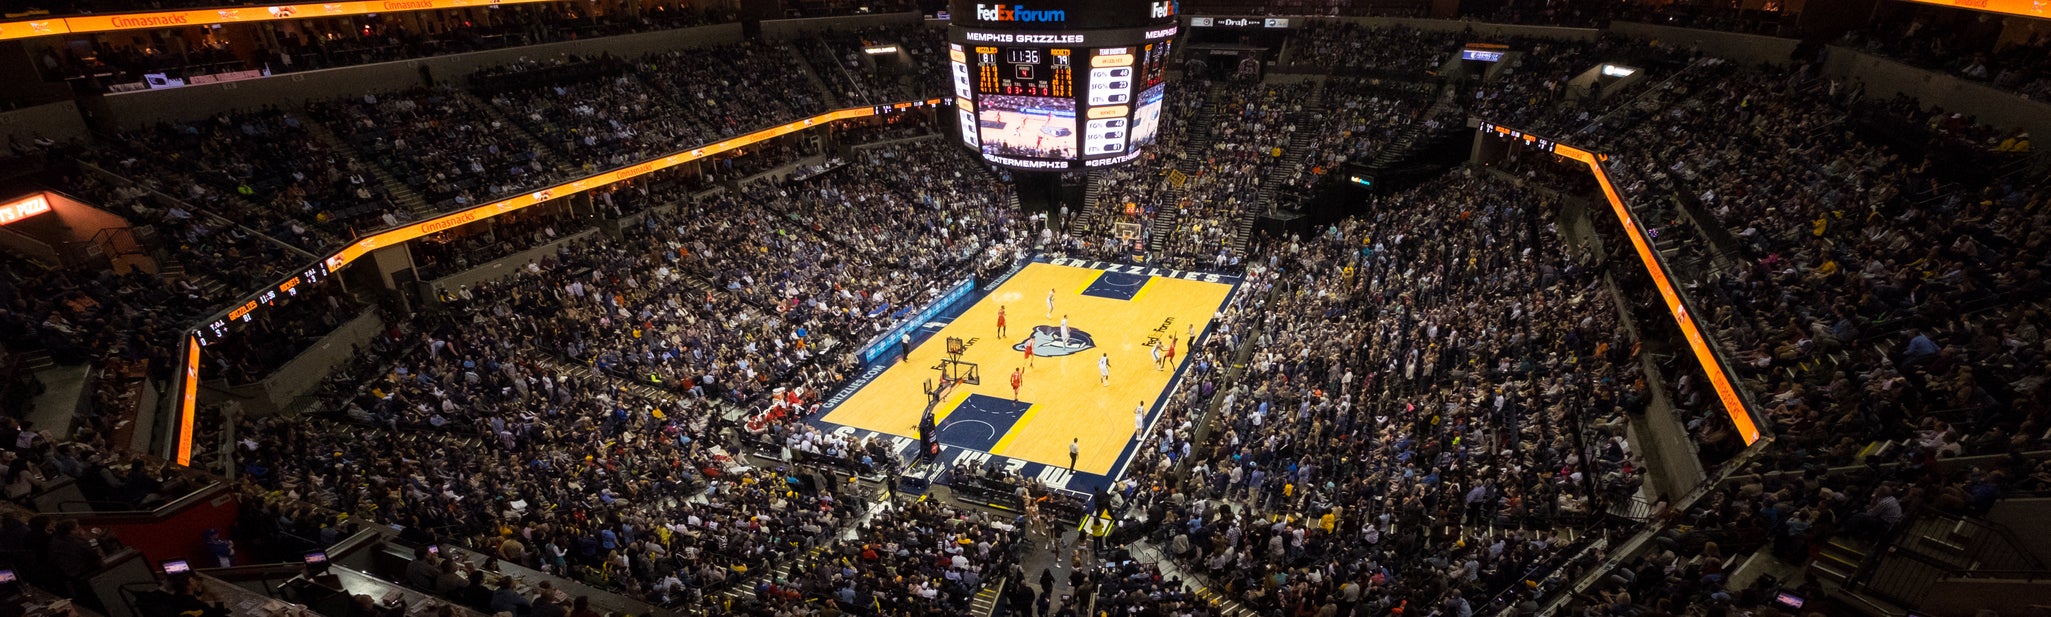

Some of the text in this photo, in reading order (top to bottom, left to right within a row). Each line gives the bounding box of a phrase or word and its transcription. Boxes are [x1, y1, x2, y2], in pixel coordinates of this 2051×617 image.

[977, 4, 1065, 21] FedExForum
[112, 14, 187, 28] Cinnasnacks
[1225, 18, 1247, 26] Draft
[967, 32, 1084, 43] MEMPHIS GRIZZLIES
[982, 53, 994, 63] 81
[1012, 50, 1038, 63] 11:36
[1057, 55, 1068, 65] 79
[16, 197, 48, 217] PIZZA
[421, 213, 475, 233] Cinnasnacks
[1050, 257, 1220, 282] GRIZZLIES
[822, 365, 886, 409] GRIZZLIES.COM
